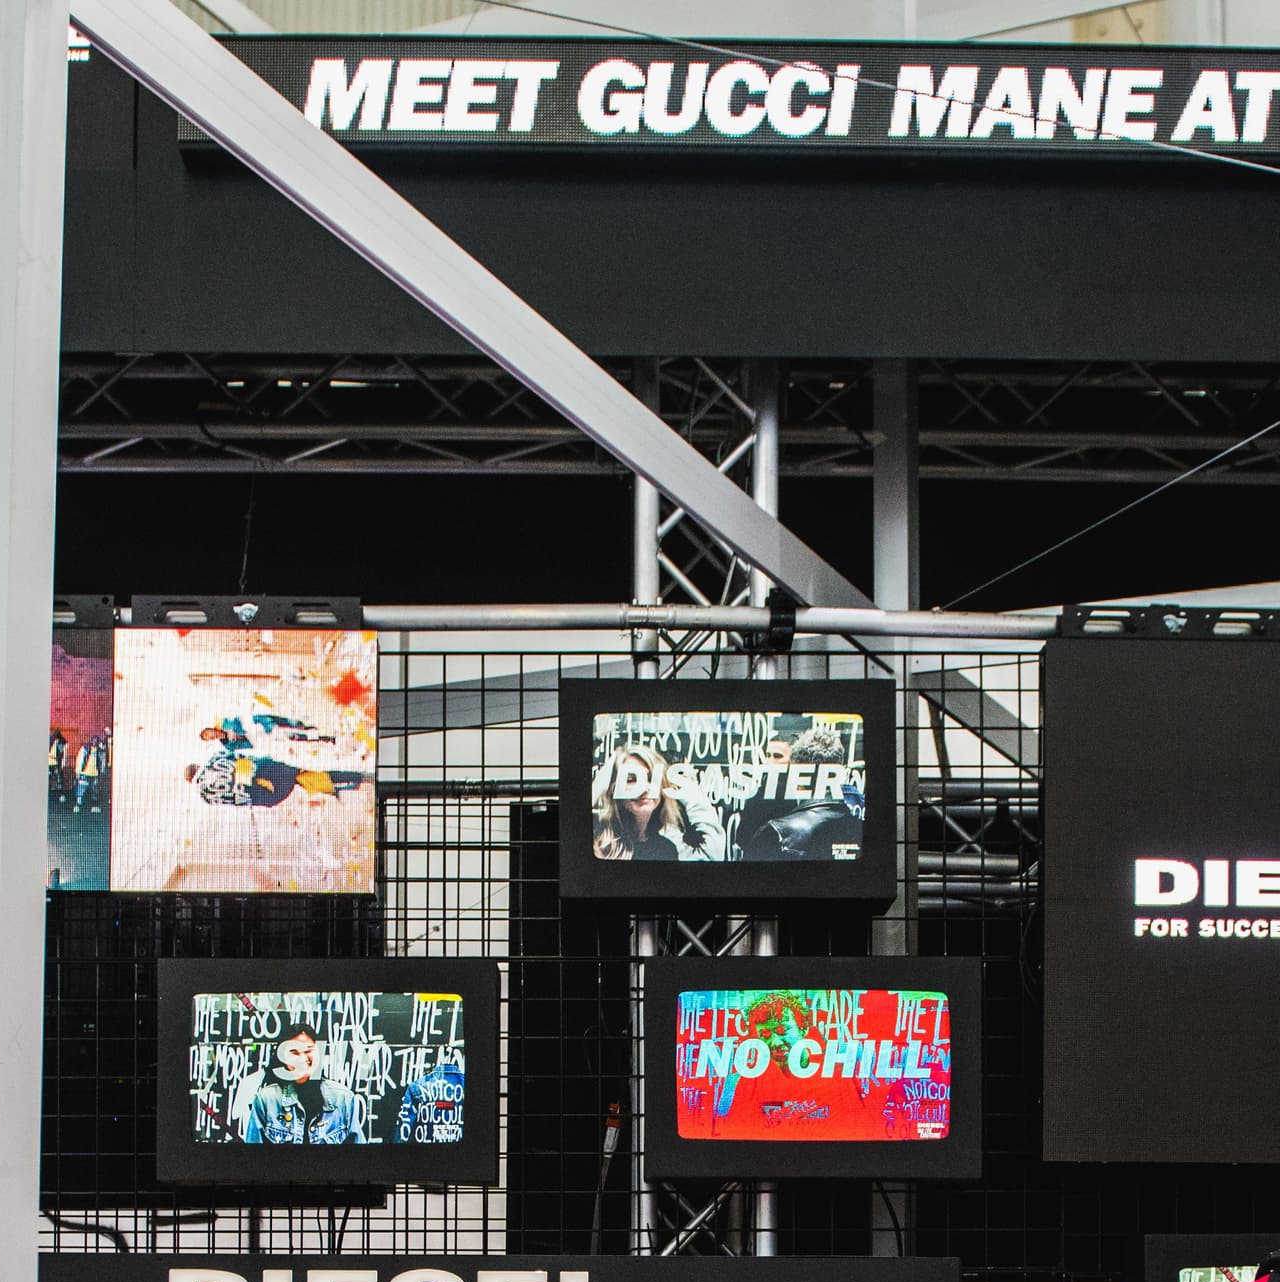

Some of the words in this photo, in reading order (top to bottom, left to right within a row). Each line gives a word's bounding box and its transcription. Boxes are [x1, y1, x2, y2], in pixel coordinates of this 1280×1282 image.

[305, 58, 560, 131] MEET
[578, 58, 861, 137] GUCCI
[888, 64, 1163, 140] MANE
[612, 762, 846, 801] DISASTER
[1134, 918, 1188, 938] FOR
[696, 1037, 771, 1079] NO
[787, 1038, 931, 1079] CHILL
